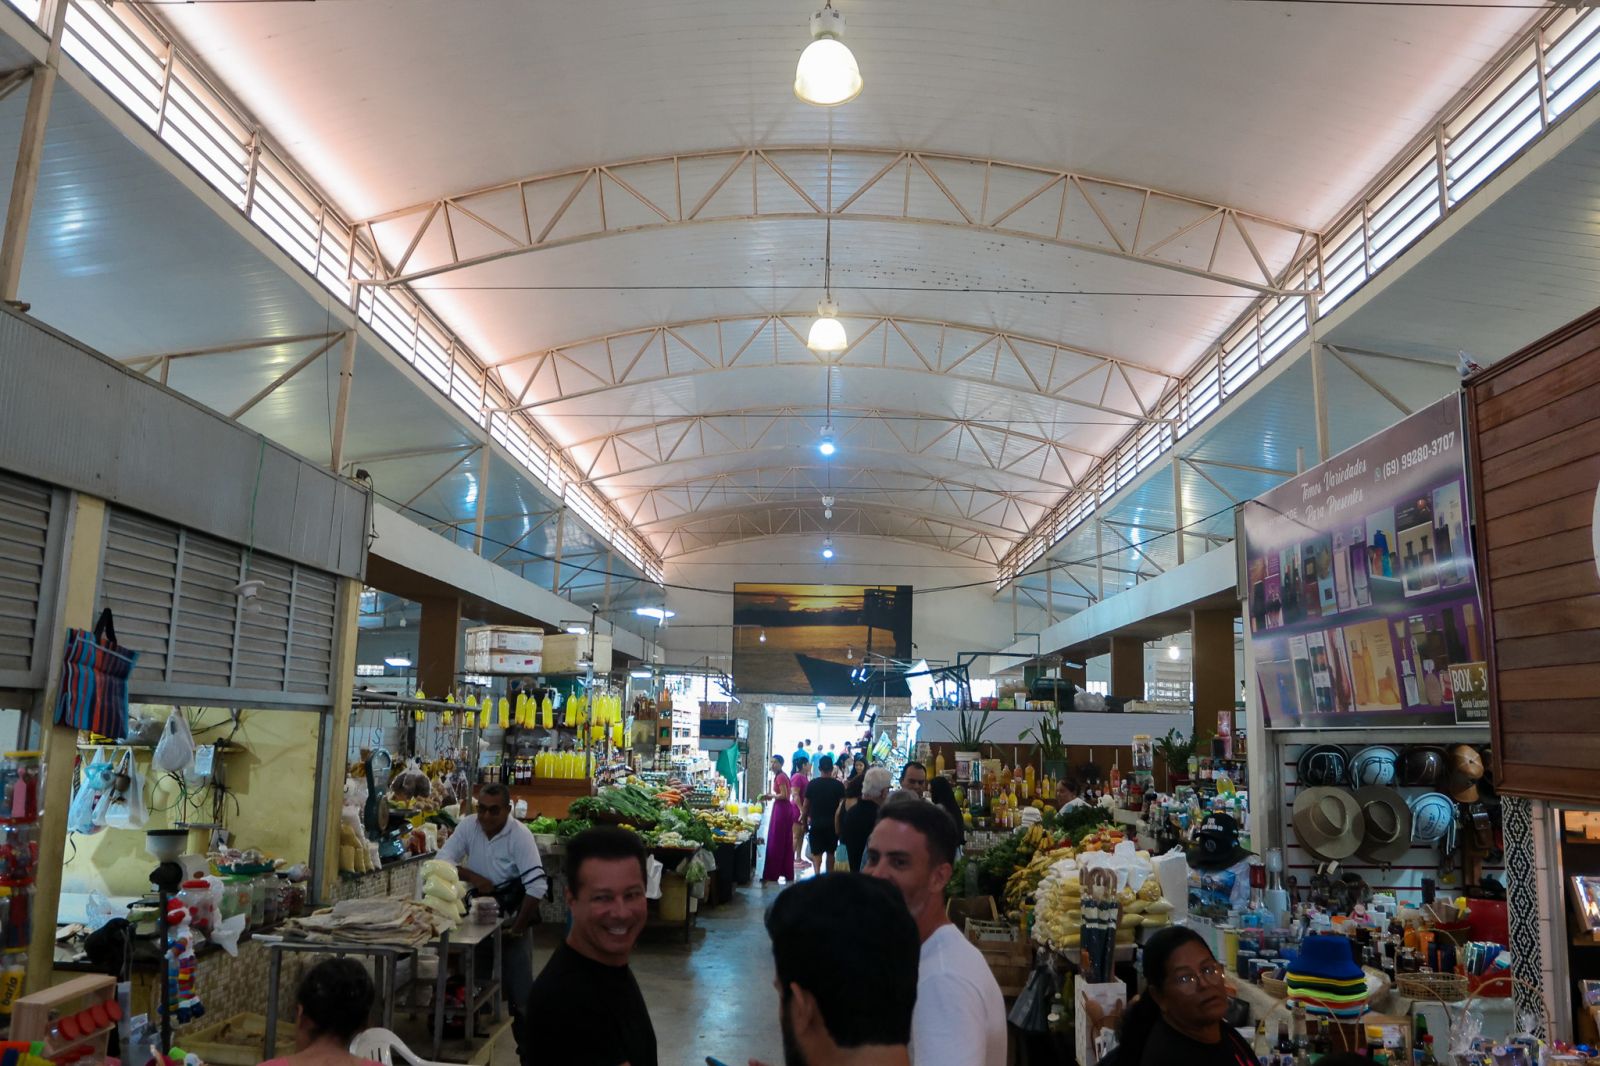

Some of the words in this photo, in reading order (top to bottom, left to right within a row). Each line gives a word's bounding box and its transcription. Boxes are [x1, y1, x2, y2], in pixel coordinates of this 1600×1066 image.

[1383, 458, 1399, 481] (69)
[1401, 431, 1455, 470] 99280-3707
[1301, 482, 1321, 502] Temos
[1323, 458, 1367, 492] Variedades
[1305, 504, 1324, 521] Para
[1326, 487, 1363, 516] Presentes
[1451, 668, 1473, 692] BOX
